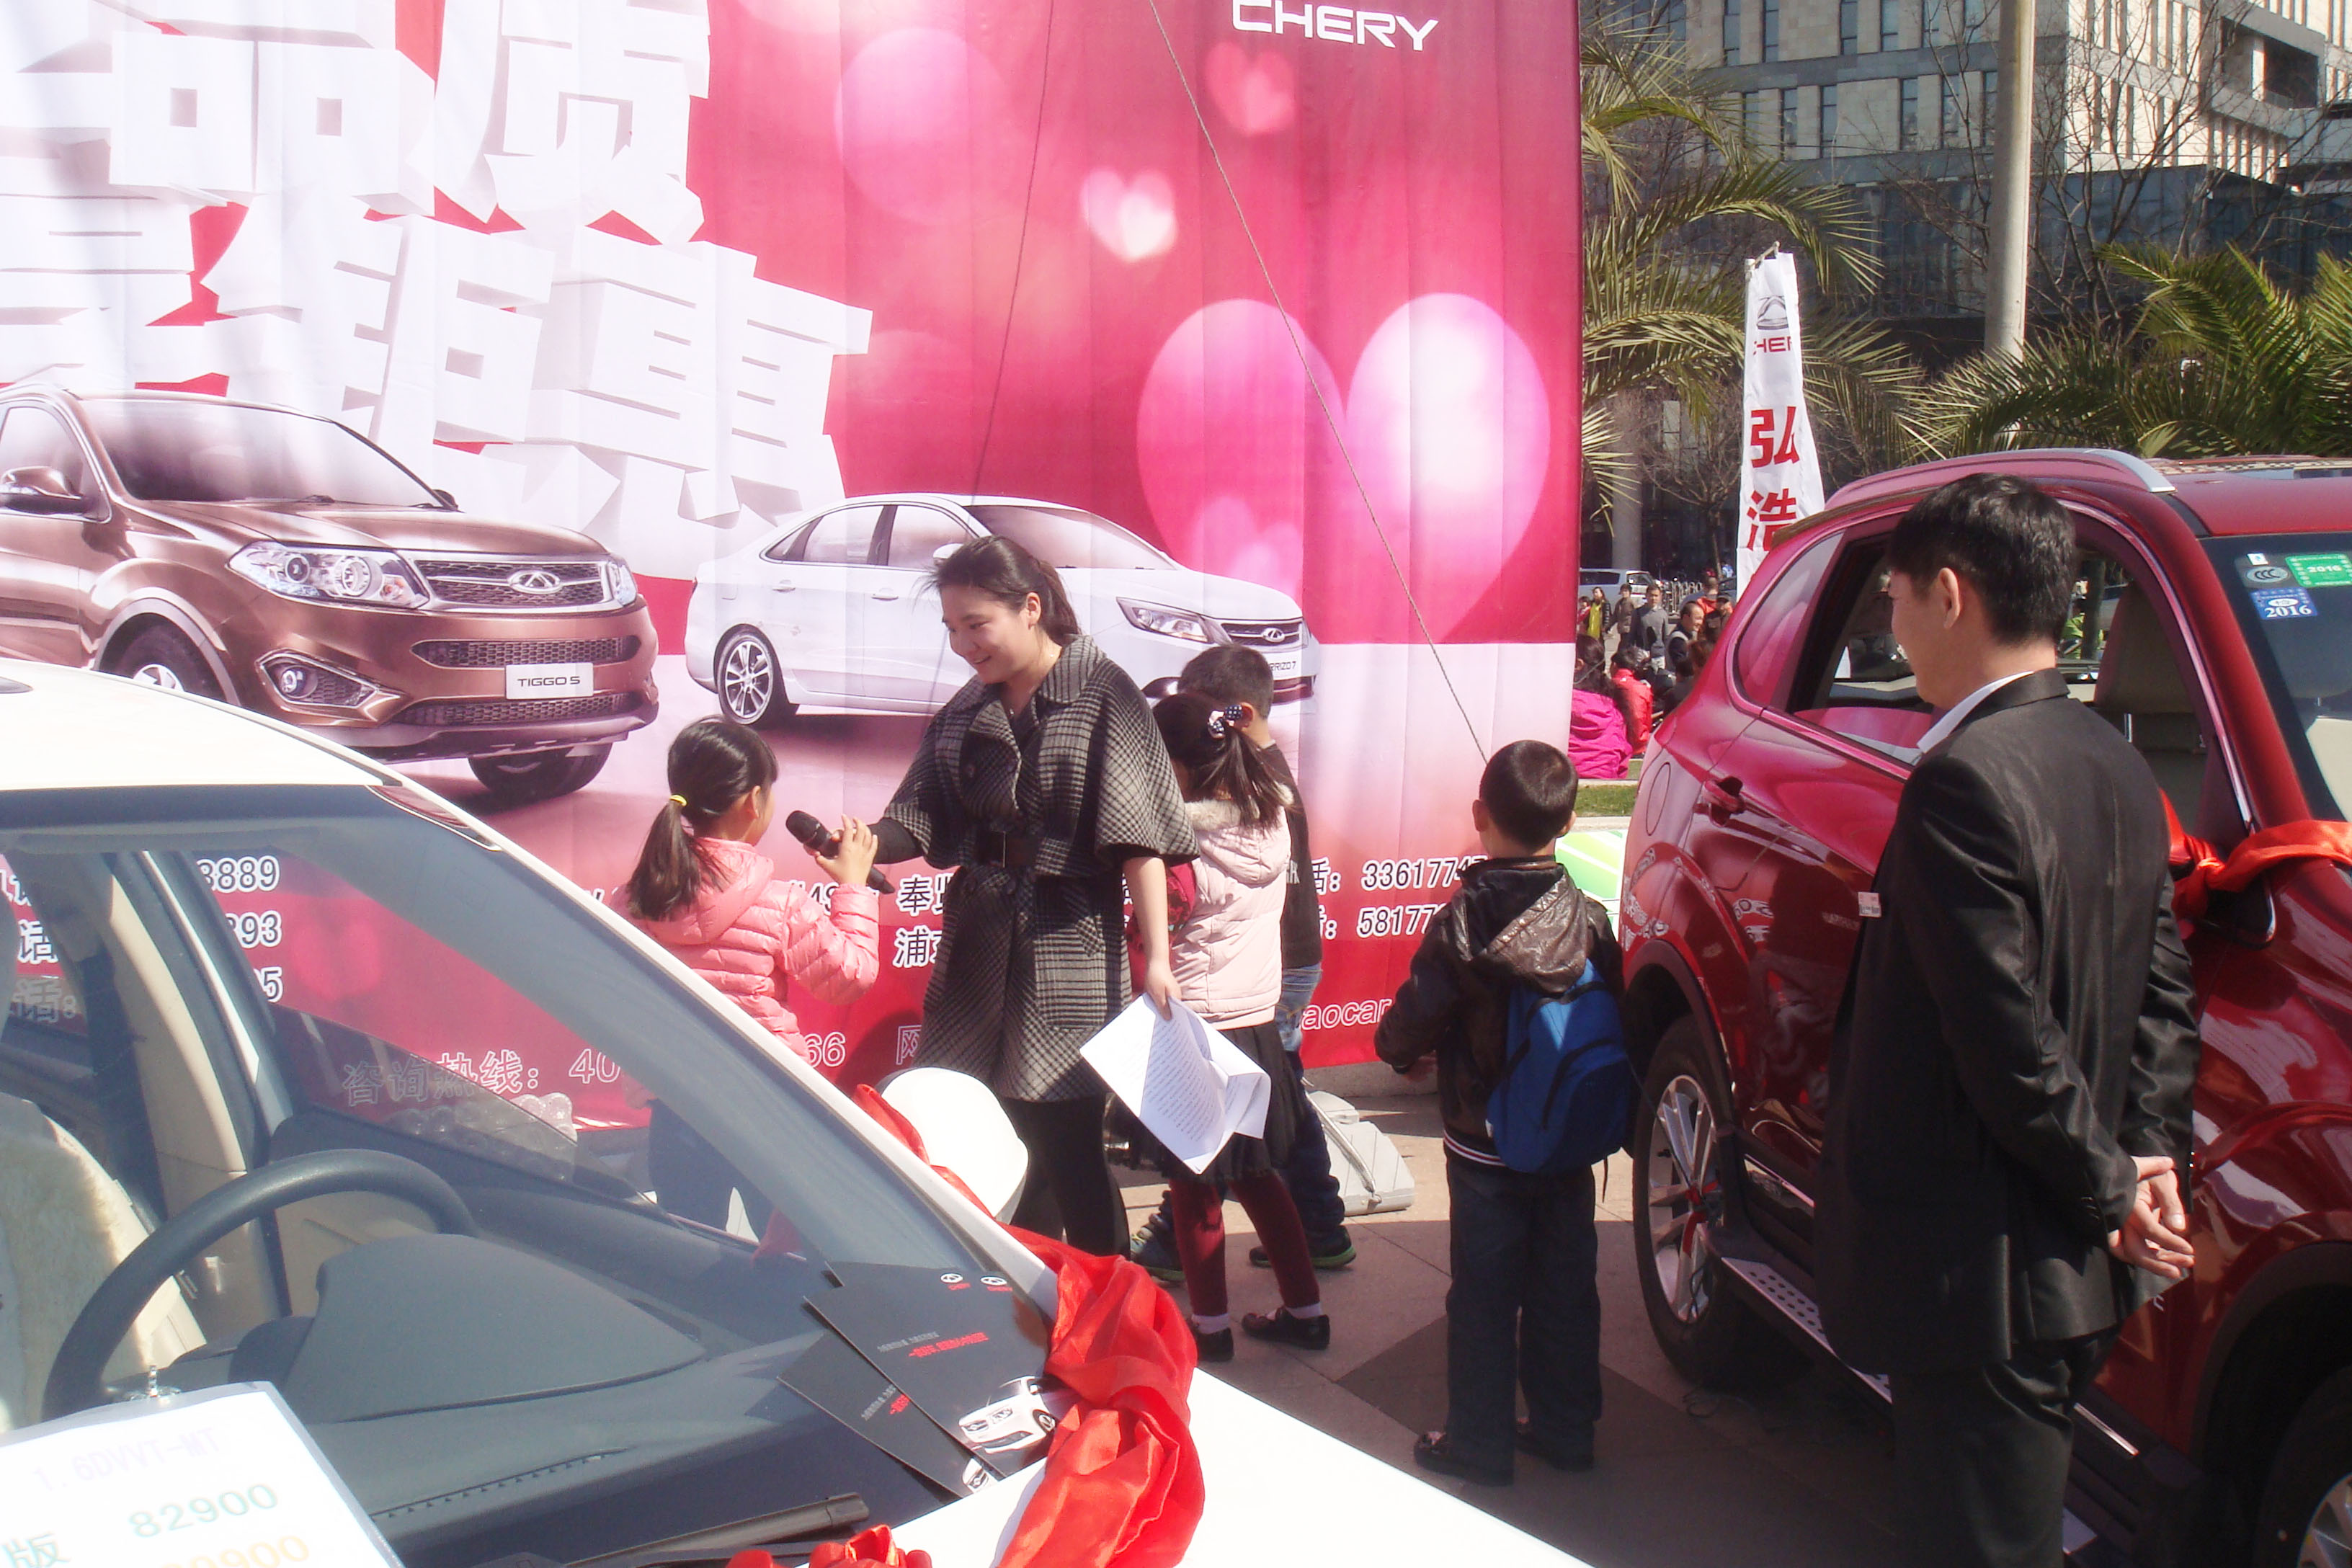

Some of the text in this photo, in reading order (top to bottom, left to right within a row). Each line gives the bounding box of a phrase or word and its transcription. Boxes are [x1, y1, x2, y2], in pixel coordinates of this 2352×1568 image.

[1232, 0, 1439, 51] CHERY
[2264, 605, 2312, 618] 2016
[517, 677, 567, 687] TIGGO
[1360, 855, 1489, 891] 3361774
[225, 910, 282, 948] 93
[1356, 903, 1447, 937] 58177
[128, 1482, 280, 1538] 82900
[160, 1534, 310, 1568] 900
